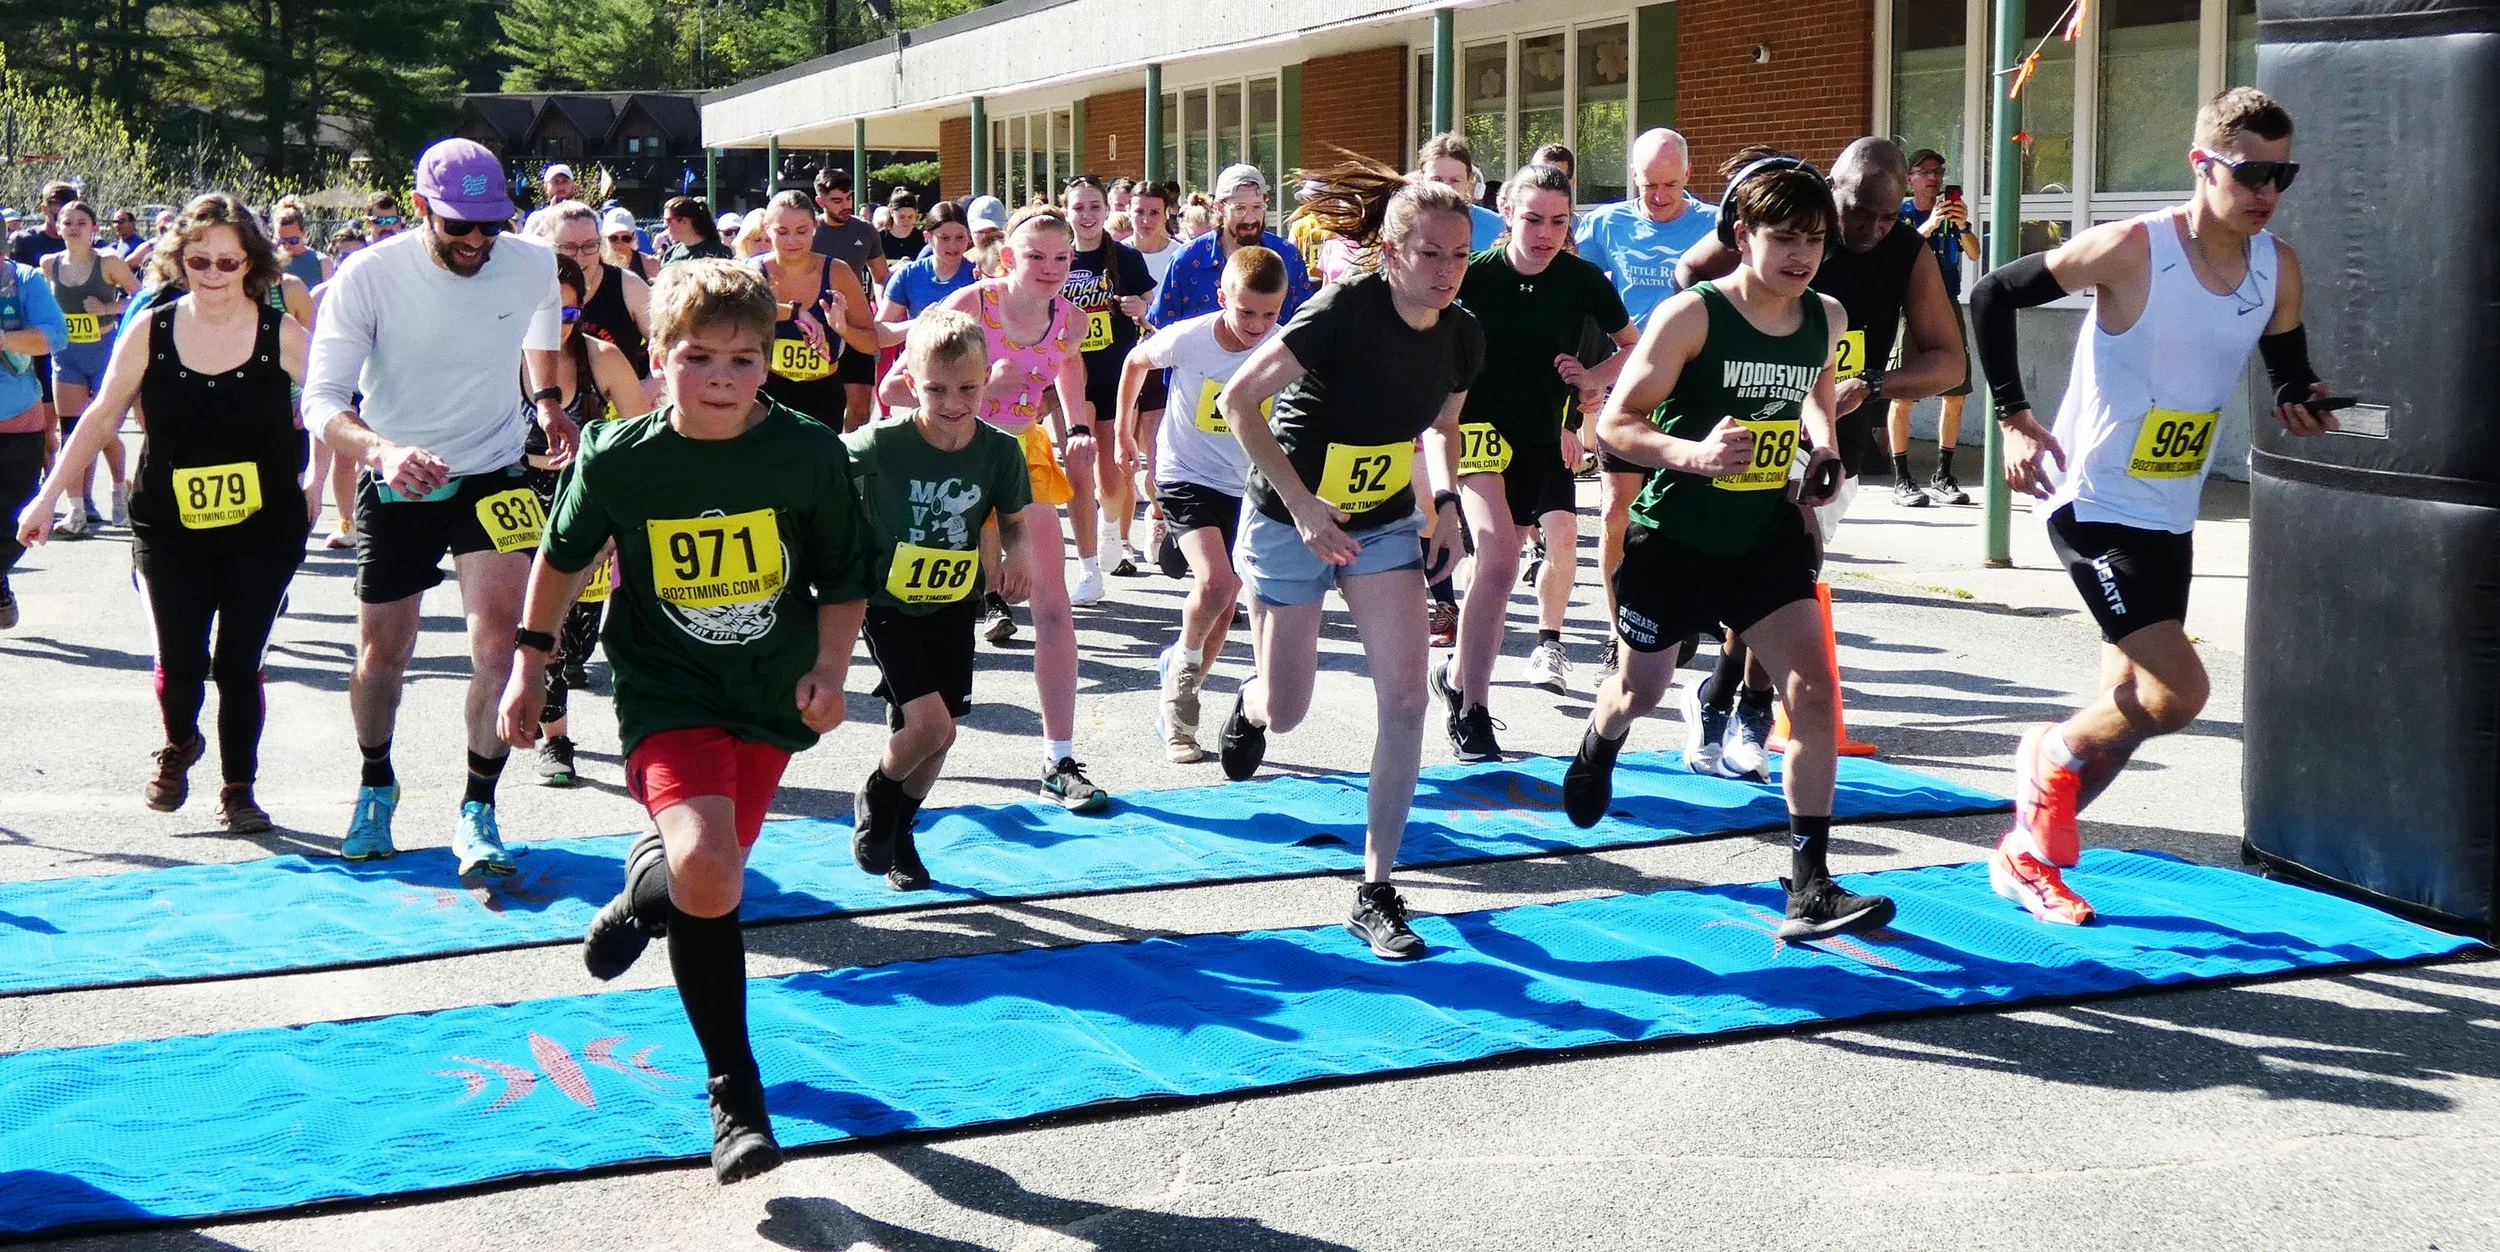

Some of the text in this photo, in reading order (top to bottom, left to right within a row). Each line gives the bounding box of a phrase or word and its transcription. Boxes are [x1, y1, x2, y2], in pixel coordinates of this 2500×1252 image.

[1062, 278, 1100, 299] FINAL
[1071, 291, 1110, 309] FOUR
[66, 317, 93, 334] 970
[782, 344, 820, 371] 955
[1836, 339, 1853, 373] 2
[1737, 387, 1806, 403] HIGH SCHOOL
[1752, 430, 1796, 469] 68
[2151, 420, 2213, 458] 964
[1348, 454, 1392, 494] 52
[188, 473, 247, 510] 879
[490, 496, 545, 531] 831
[1340, 502, 1357, 511] 802
[669, 526, 758, 582] 971
[905, 557, 972, 589] 168
[2092, 554, 2127, 616] USATF
[661, 579, 761, 602] 802TIMING.COM
[906, 593, 953, 602] 802 TIMING
[687, 622, 710, 637] MAY
[1617, 617, 1656, 644] LIFTING
